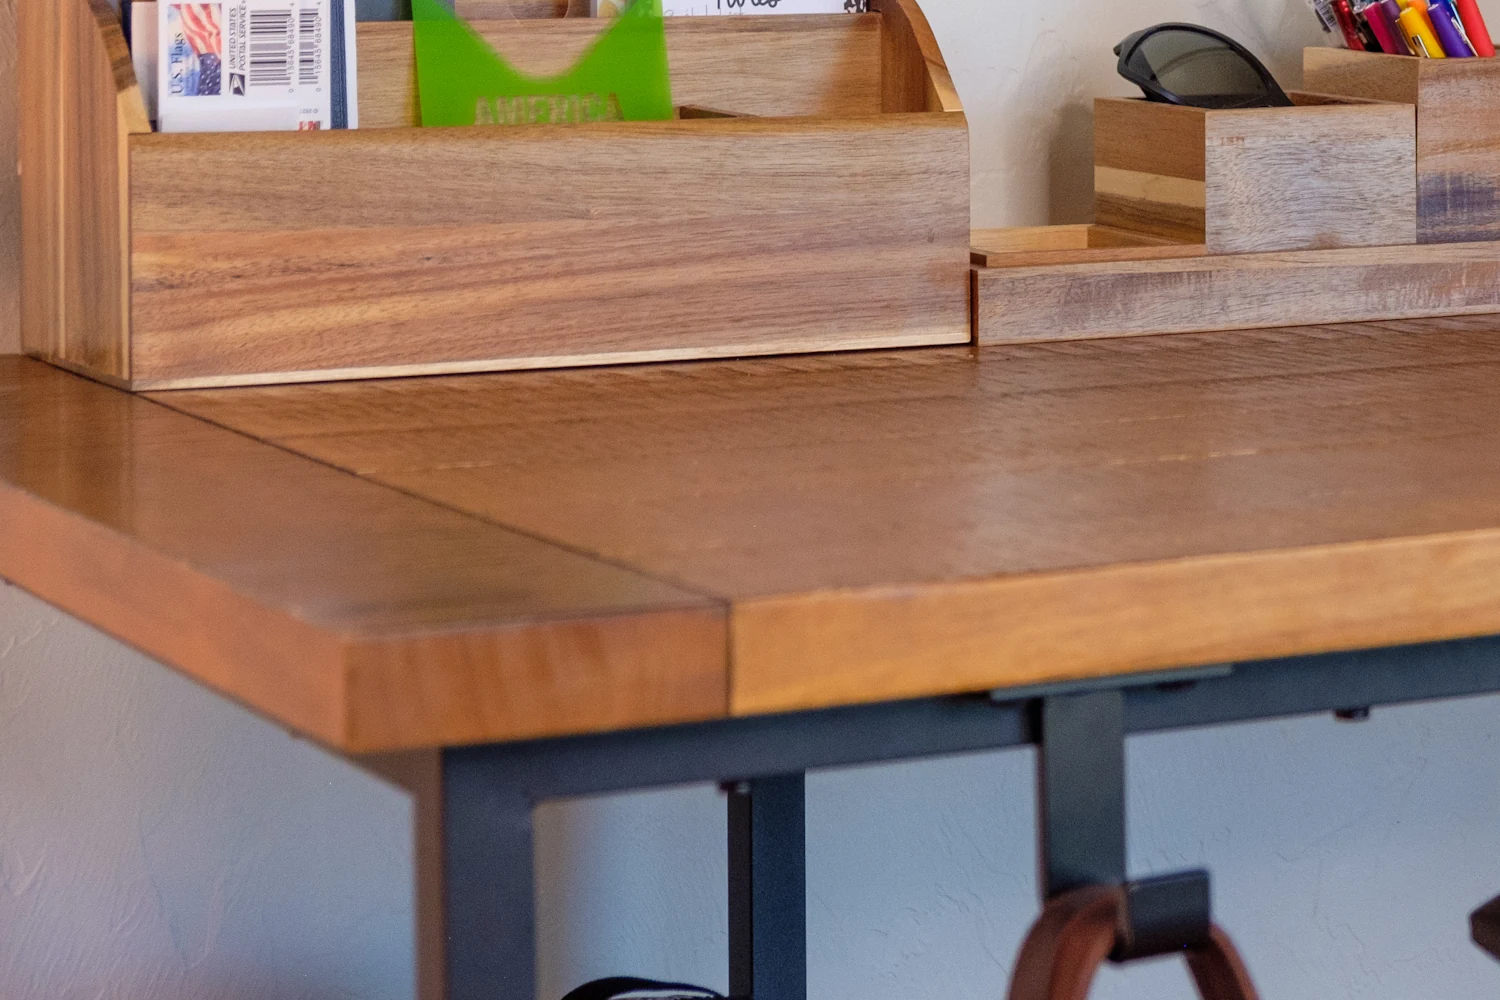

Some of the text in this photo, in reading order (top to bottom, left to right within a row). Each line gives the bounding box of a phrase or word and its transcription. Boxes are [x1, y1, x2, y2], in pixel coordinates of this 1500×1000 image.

[229, 7, 237, 69] UNITED STATES
[238, 44, 246, 71] POSTAL
[171, 32, 186, 94] U.S. Flags
[475, 92, 624, 125] AMERICA
